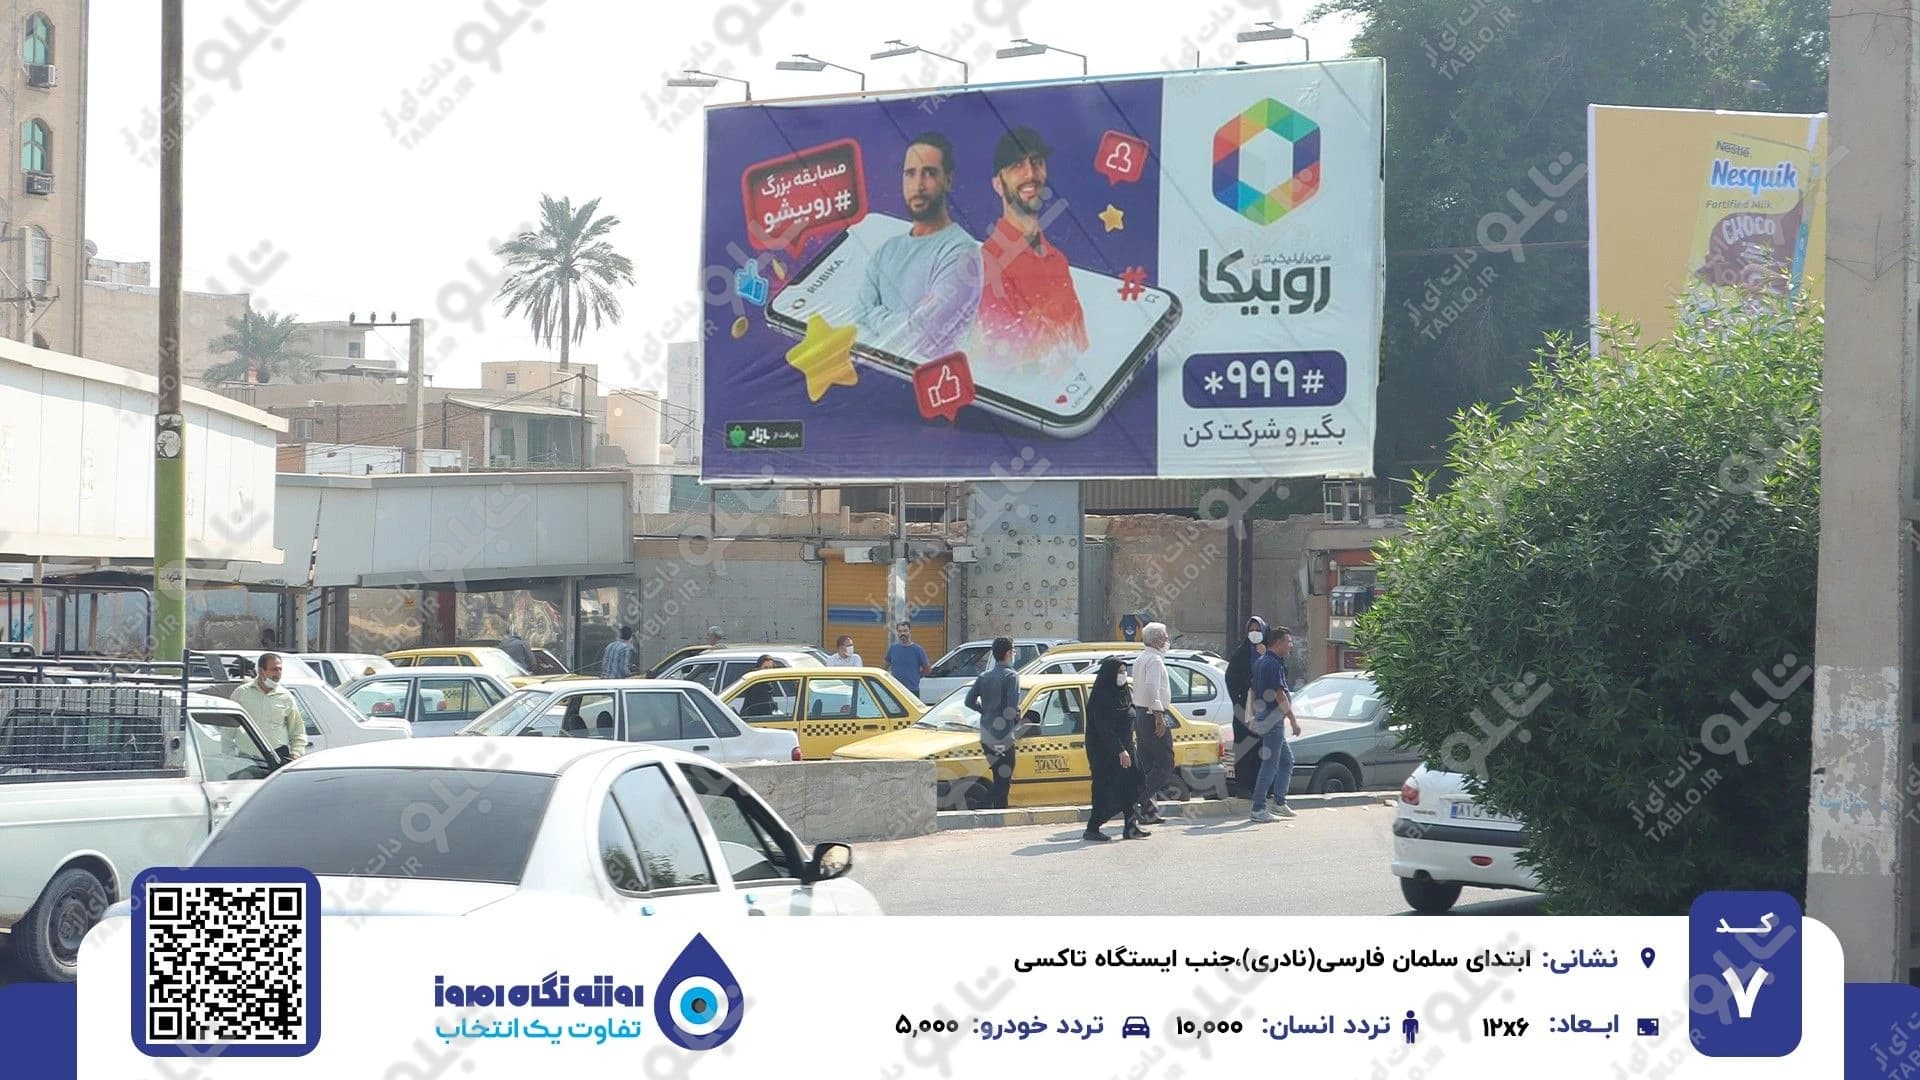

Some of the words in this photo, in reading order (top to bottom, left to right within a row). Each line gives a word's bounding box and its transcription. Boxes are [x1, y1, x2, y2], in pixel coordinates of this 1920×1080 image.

[761, 174, 792, 198] بزرگ
[793, 163, 847, 187] مسابقه
[1709, 158, 1799, 197] Nesquik
[1705, 200, 1749, 209] Fortified
[1750, 201, 1773, 209] Milk
[1721, 215, 1776, 246] CHOCO
[1198, 248, 1331, 315] روبیکا
[1183, 420, 1214, 447] کن
[1218, 418, 1281, 447] شرکت
[1285, 425, 1297, 447] و
[1299, 413, 1346, 446] بگیر
